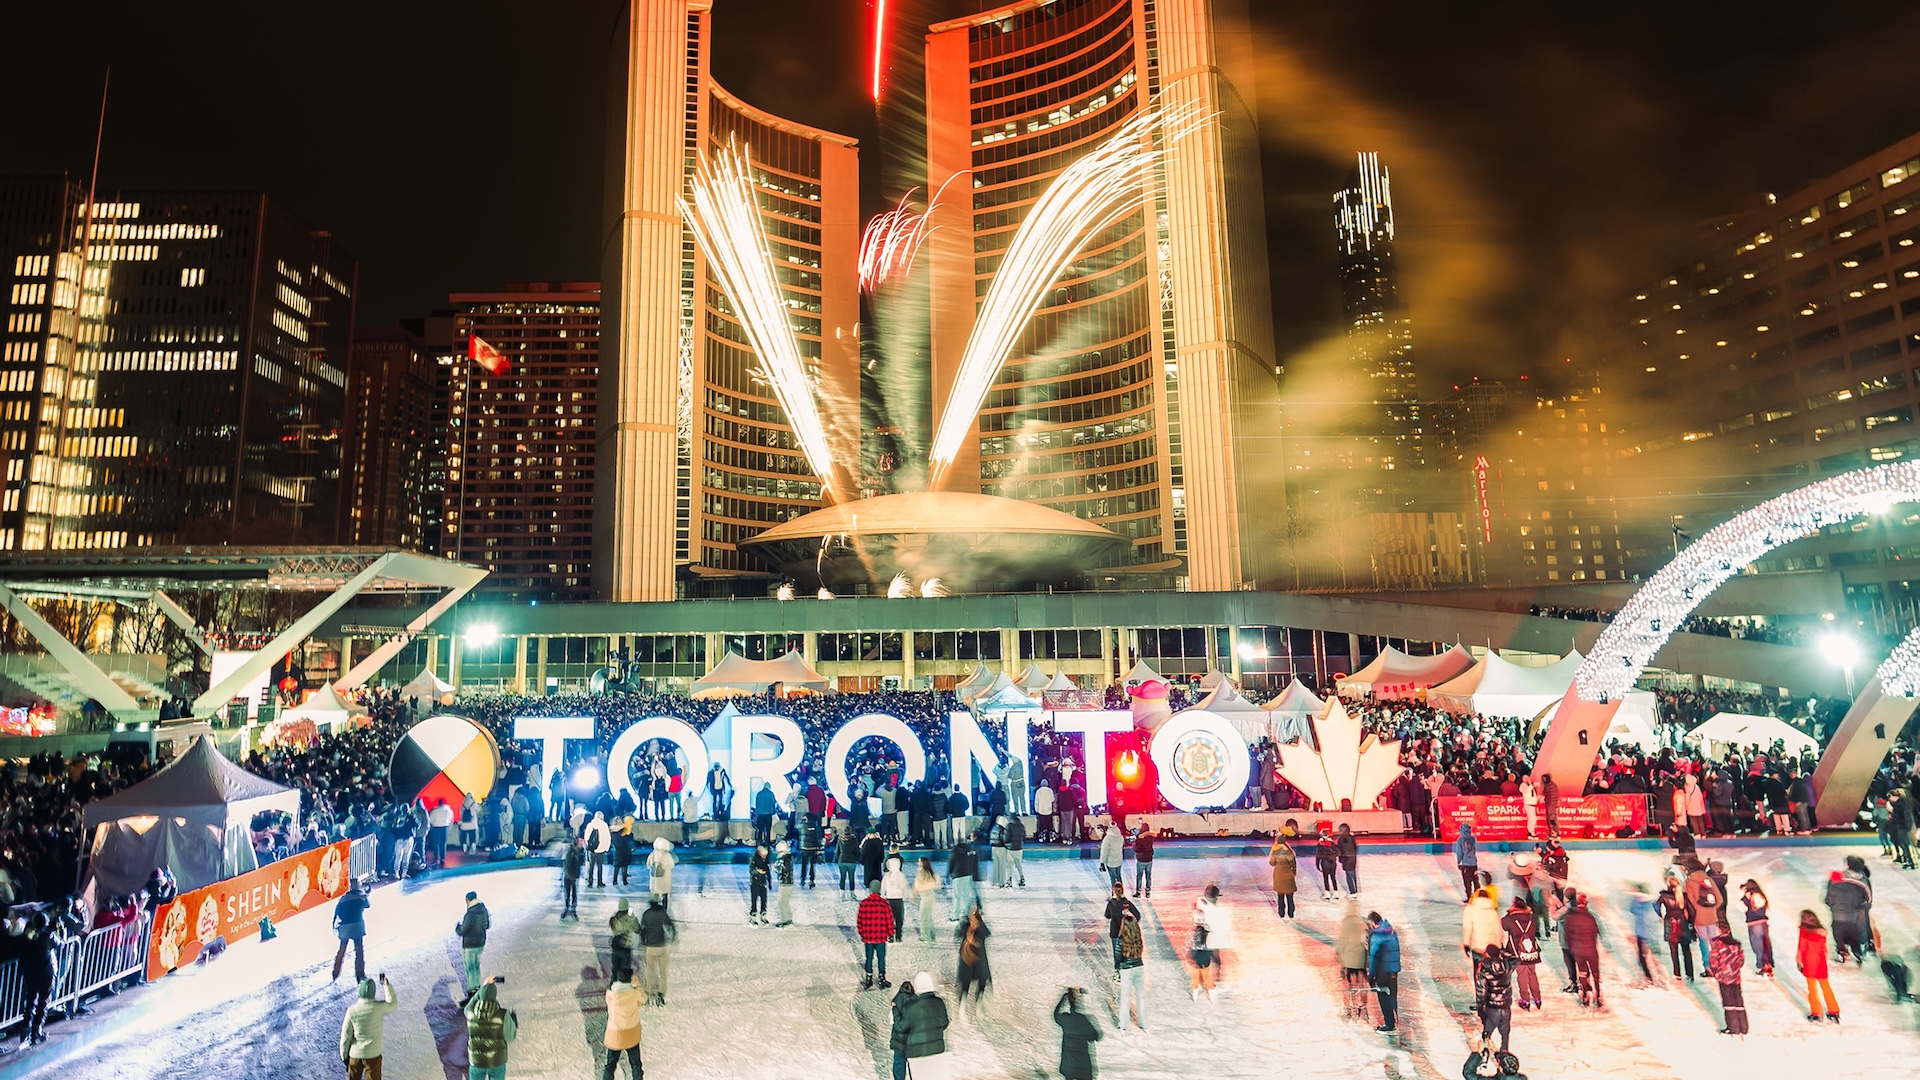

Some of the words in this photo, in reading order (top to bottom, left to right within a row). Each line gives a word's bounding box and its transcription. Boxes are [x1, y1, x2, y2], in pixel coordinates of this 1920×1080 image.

[1474, 456, 1491, 542] Marriott
[514, 710, 1251, 821] TORONTO
[1486, 805, 1520, 815] SPARK
[1559, 807, 1576, 815] New
[1577, 806, 1598, 815] Year!
[226, 879, 281, 923] SHEIN
